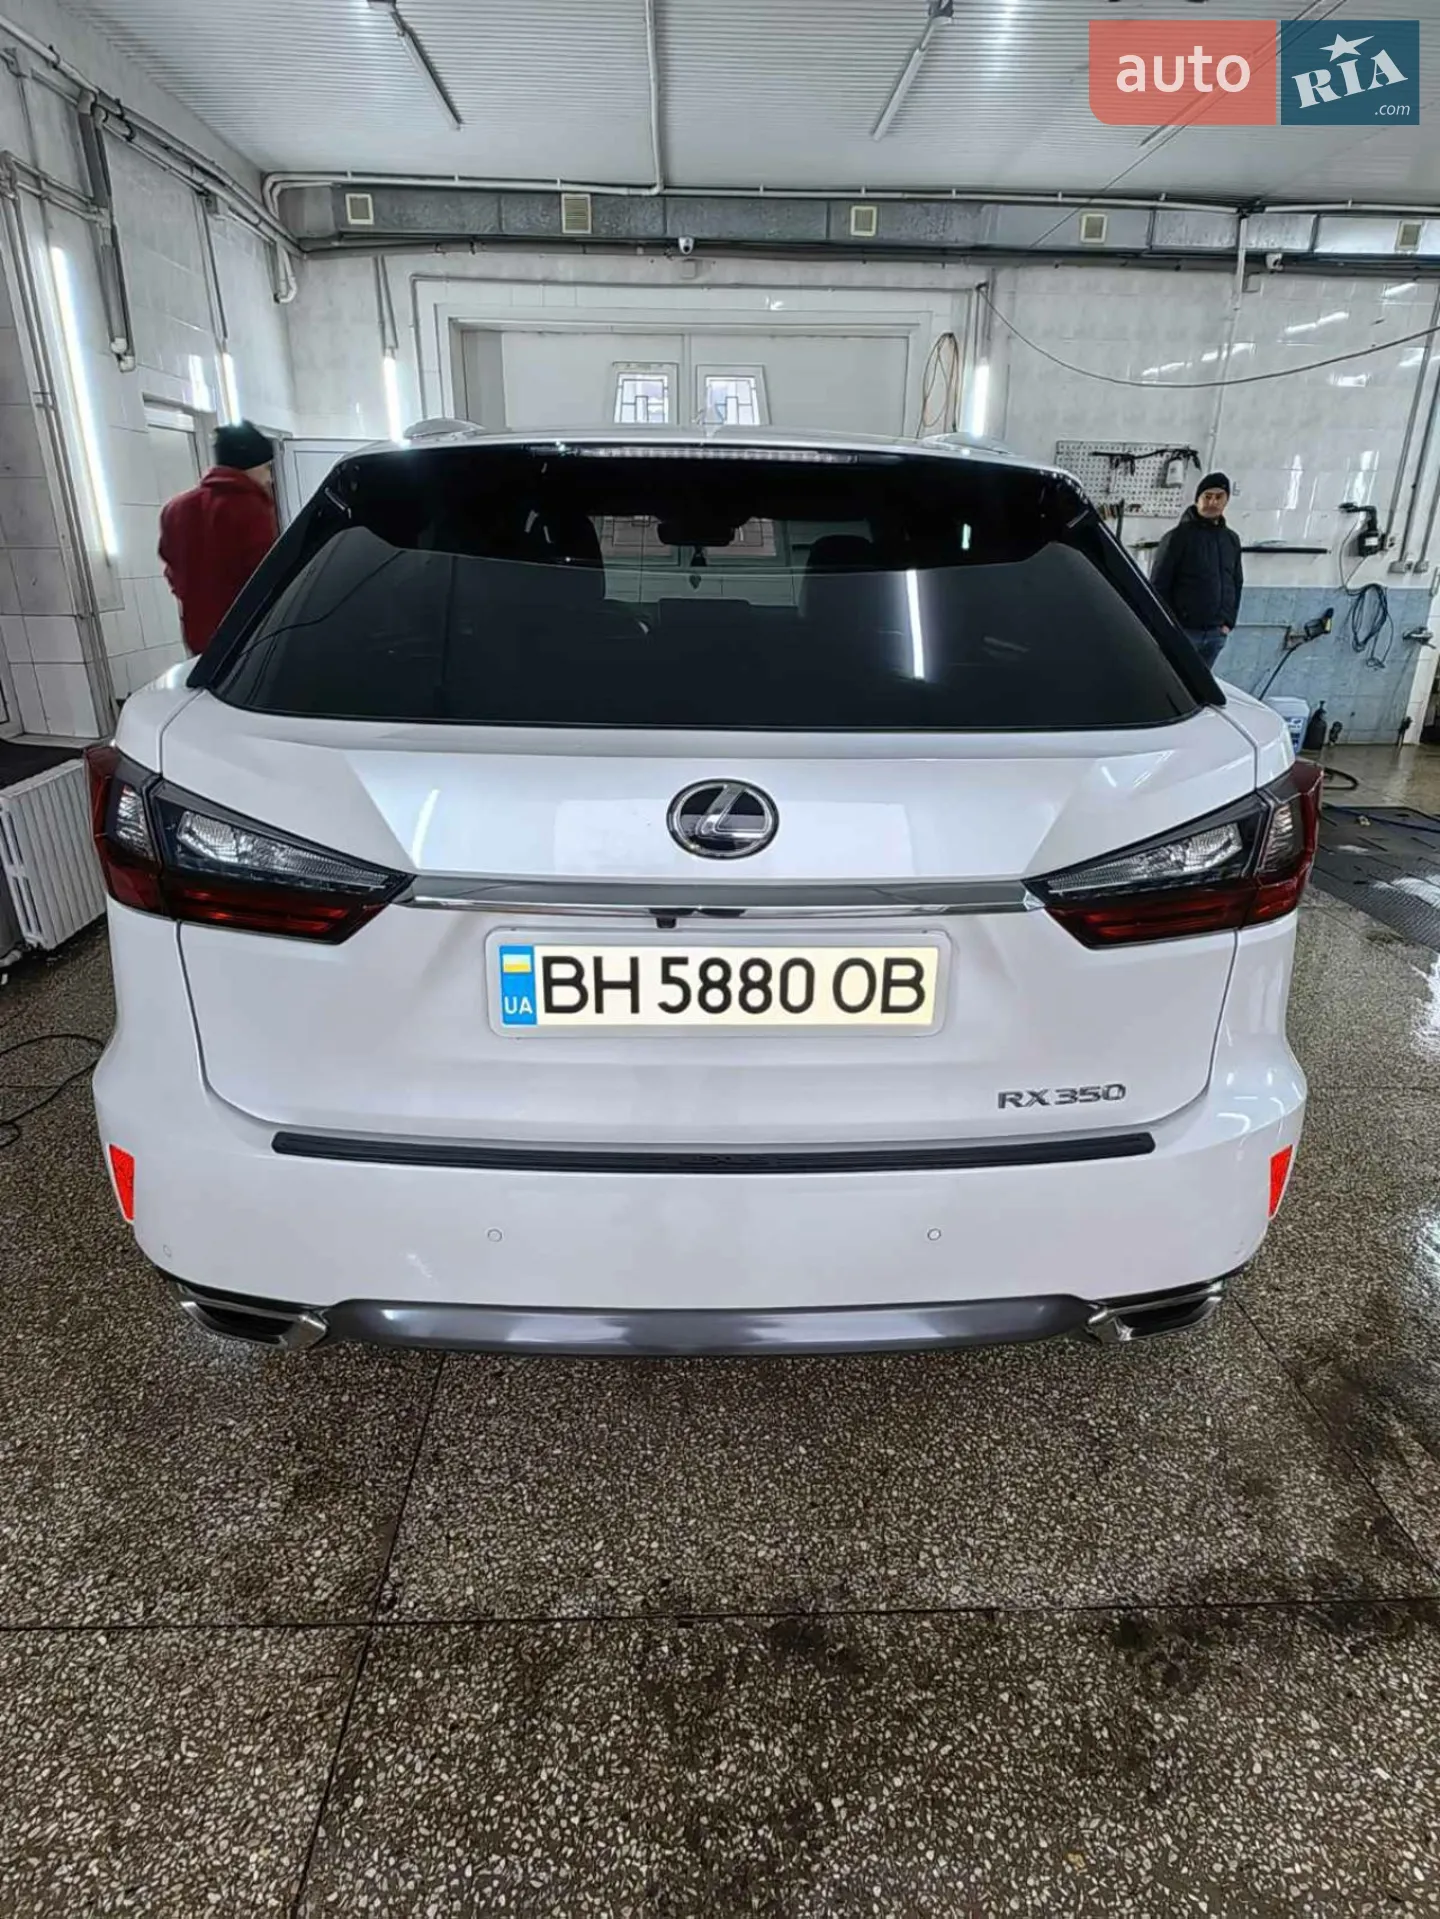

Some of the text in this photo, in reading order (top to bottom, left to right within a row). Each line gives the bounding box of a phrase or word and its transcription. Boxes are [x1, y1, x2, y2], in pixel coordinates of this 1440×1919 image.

[541, 955, 926, 1014] BH 5880 OB
[504, 996, 533, 1014] UA
